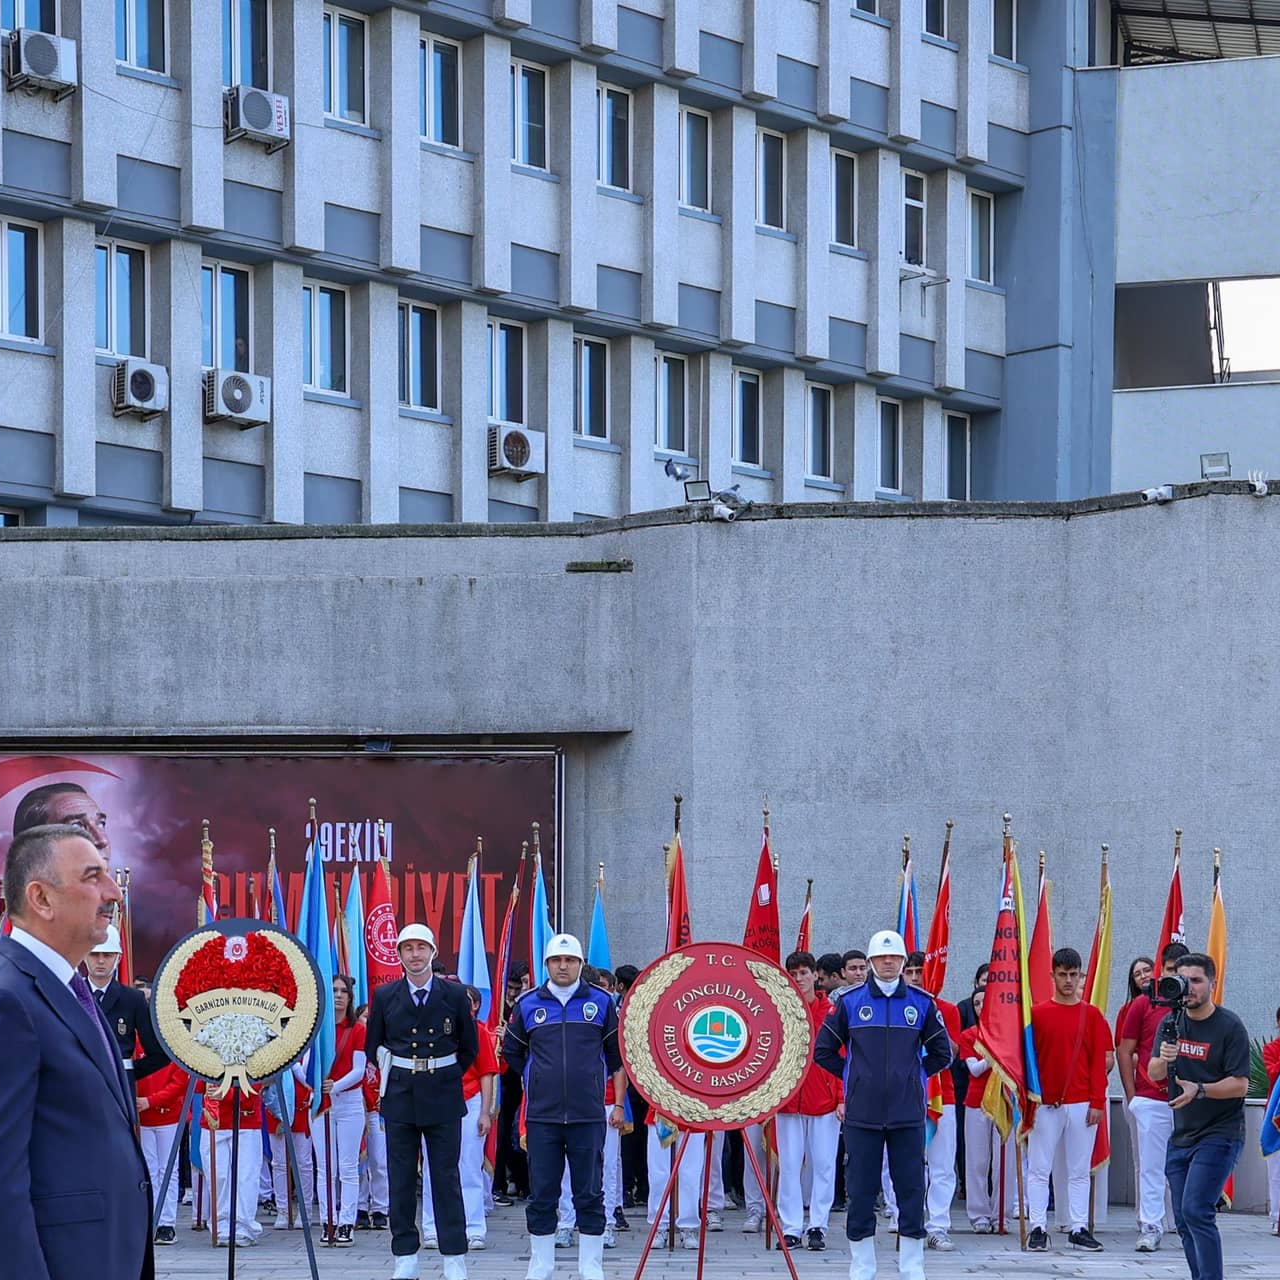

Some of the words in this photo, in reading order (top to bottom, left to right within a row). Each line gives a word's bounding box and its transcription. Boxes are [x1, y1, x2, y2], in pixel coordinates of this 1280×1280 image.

[194, 996, 230, 1014] GARNİZON
[231, 996, 278, 1014] KOMUTANLIĞI
[673, 983, 764, 1017] ZONGULDAK
[663, 1024, 704, 1083] BELEDİYE
[710, 1031, 772, 1088] BAŞKANLIĞI
